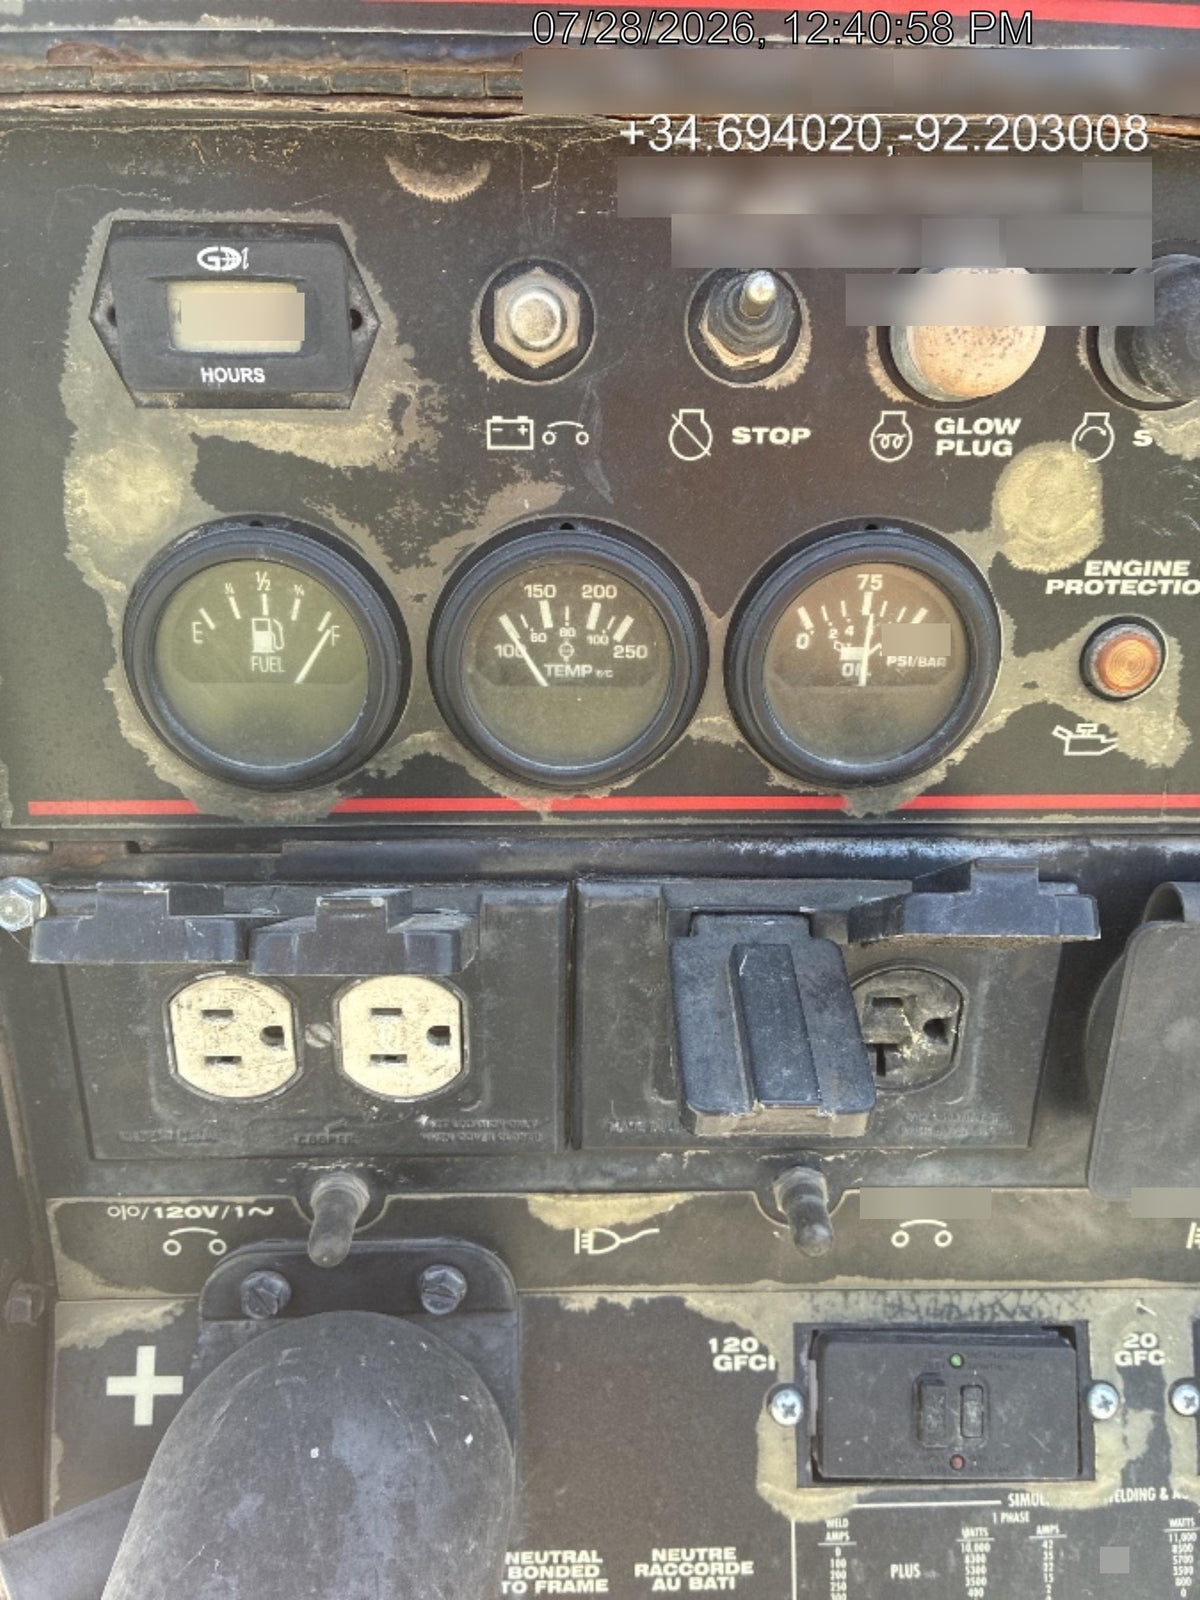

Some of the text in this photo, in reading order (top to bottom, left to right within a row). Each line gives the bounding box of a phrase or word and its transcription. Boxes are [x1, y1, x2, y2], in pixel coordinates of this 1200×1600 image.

[201, 366, 265, 383] HOURS
[934, 416, 1022, 437] GLOW
[732, 426, 811, 446] STOP
[935, 438, 1015, 458] PLUG
[1084, 559, 1191, 577] ENGINE
[856, 574, 883, 591] 75
[524, 584, 557, 599] 150
[581, 584, 618, 599] 200
[191, 622, 204, 644] E
[331, 625, 341, 647] F
[828, 628, 839, 639] 2
[844, 625, 855, 637] 4
[795, 633, 810, 650] 0
[612, 644, 648, 659] 250
[251, 656, 286, 673] FUEL
[886, 655, 947, 668] PSI/BAR
[544, 664, 593, 678] TEMP
[708, 1336, 760, 1354] 120
[712, 1354, 776, 1372] GFCI
[825, 1518, 849, 1529] WELD
[1000, 1511, 1030, 1524] PHASE
[1168, 1517, 1196, 1528] WATTS
[825, 1531, 850, 1541] AMPS
[961, 1527, 989, 1538] WATTS
[1036, 1524, 1060, 1535] AMPS
[504, 1550, 603, 1565] NEUTRAL
[651, 1547, 737, 1562] NEUTRE
[507, 1564, 600, 1579] BONDED
[634, 1561, 754, 1577] RACCORDE
[890, 1563, 921, 1579] PLUS
[501, 1578, 609, 1594] TO FRAME
[652, 1576, 736, 1592] AU BATI
